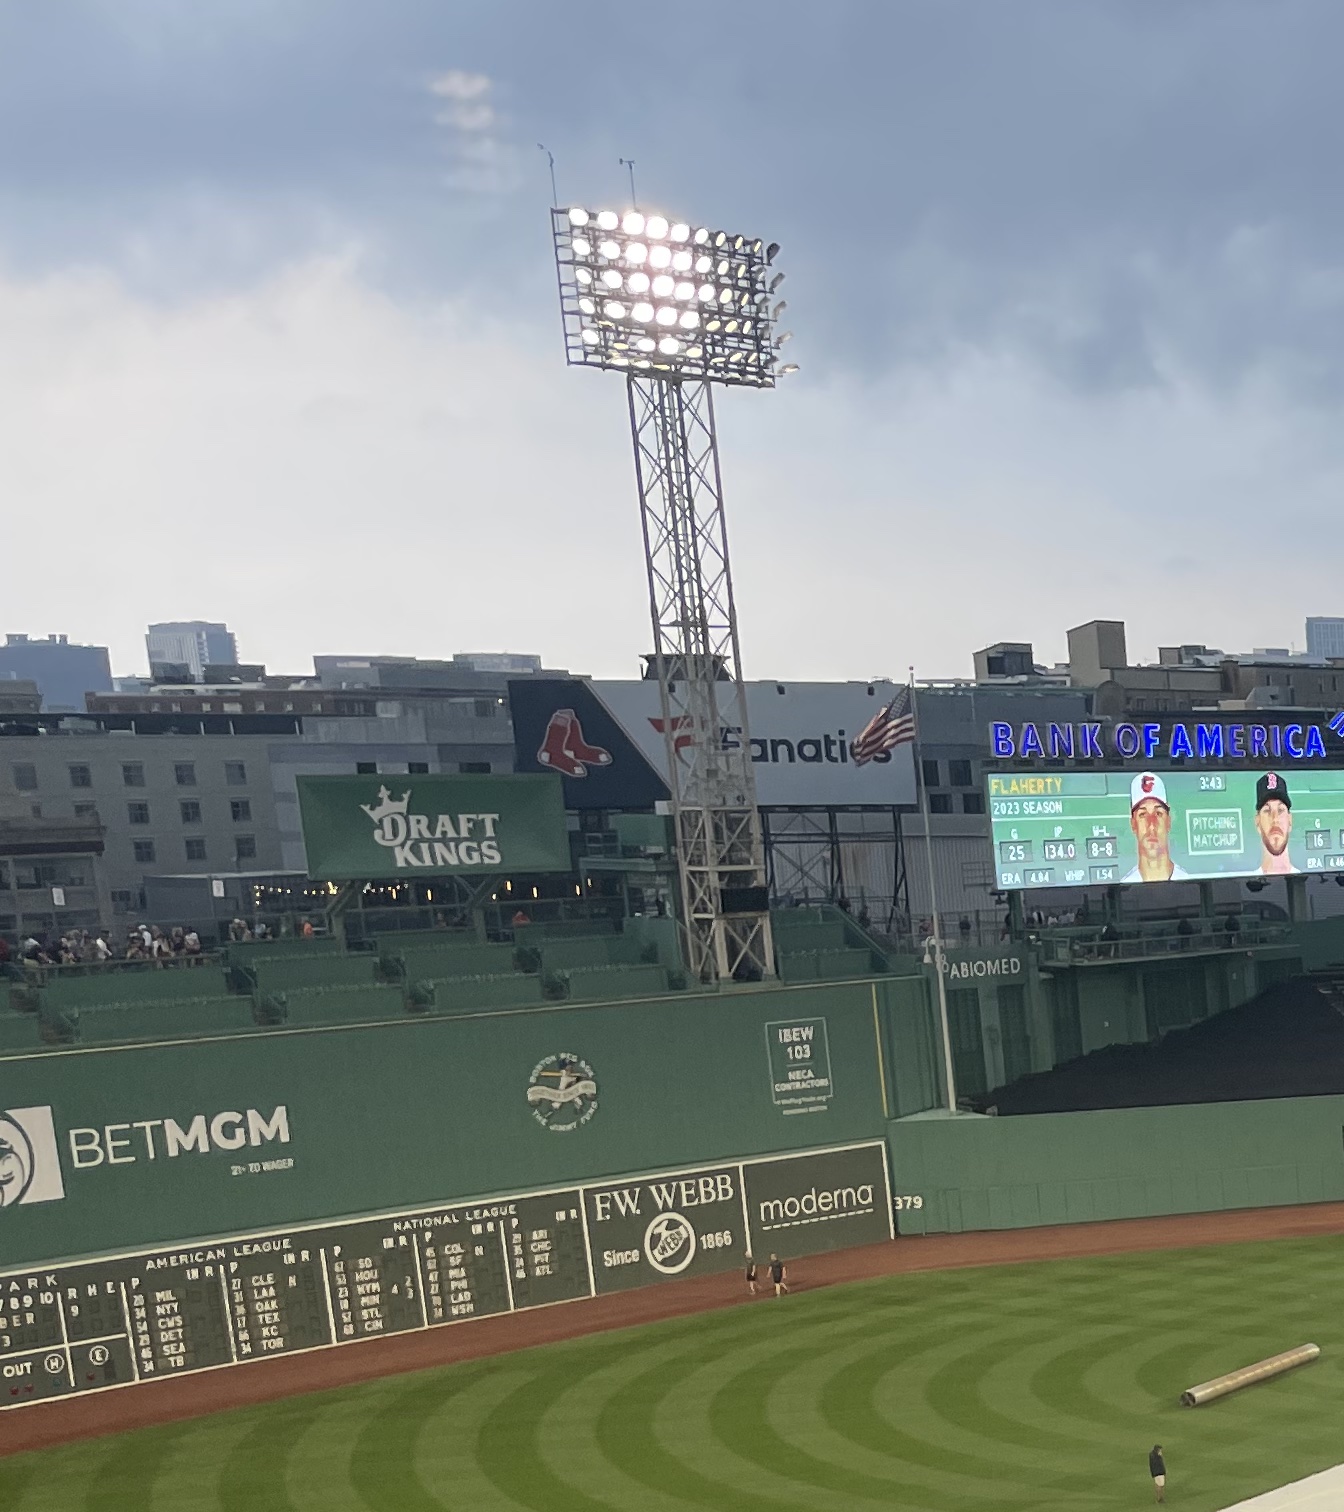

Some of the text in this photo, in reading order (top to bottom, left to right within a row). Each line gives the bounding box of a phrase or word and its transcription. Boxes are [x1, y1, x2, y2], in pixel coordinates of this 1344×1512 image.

[989, 721, 1327, 758] BANK OF AMERICA
[991, 777, 1063, 795] FLAHERTY
[1200, 776, 1222, 790] 3:43
[994, 801, 1063, 815] 2023 SEASON
[374, 812, 500, 847] DRAFT
[1193, 816, 1237, 831] PITCHING
[1193, 832, 1238, 847] MATCHUP
[1313, 833, 1324, 848] 16
[394, 840, 502, 867] KINGS
[1008, 842, 1113, 861] 25 134.0 8-8
[1001, 872, 1021, 884] ERA
[1065, 869, 1084, 881] WHIP
[950, 957, 1021, 979] ABIOMED
[779, 1026, 814, 1043] IBEW
[787, 1044, 811, 1059] 103
[788, 1069, 815, 1080] NECA
[69, 1105, 291, 1168] BETMGM
[649, 1174, 734, 1211] WEBB
[760, 1183, 874, 1222] moderna
[895, 1195, 923, 1210] 379
[393, 1204, 517, 1232] NATIONAL LEAGUE
[700, 1230, 732, 1250] 1866
[145, 1238, 292, 1271] AMERICAN LEAGUE
[604, 1249, 640, 1268] Since
[252, 1273, 275, 1286] CLE
[40, 1292, 54, 1305] 10
[155, 1289, 177, 1302] MIL
[155, 1302, 179, 1315] NYY
[157, 1315, 183, 1329] CWS
[160, 1328, 183, 1342] DET
[162, 1343, 186, 1356] SEA
[3, 1361, 33, 1377] OUT
[168, 1356, 184, 1368] TB
